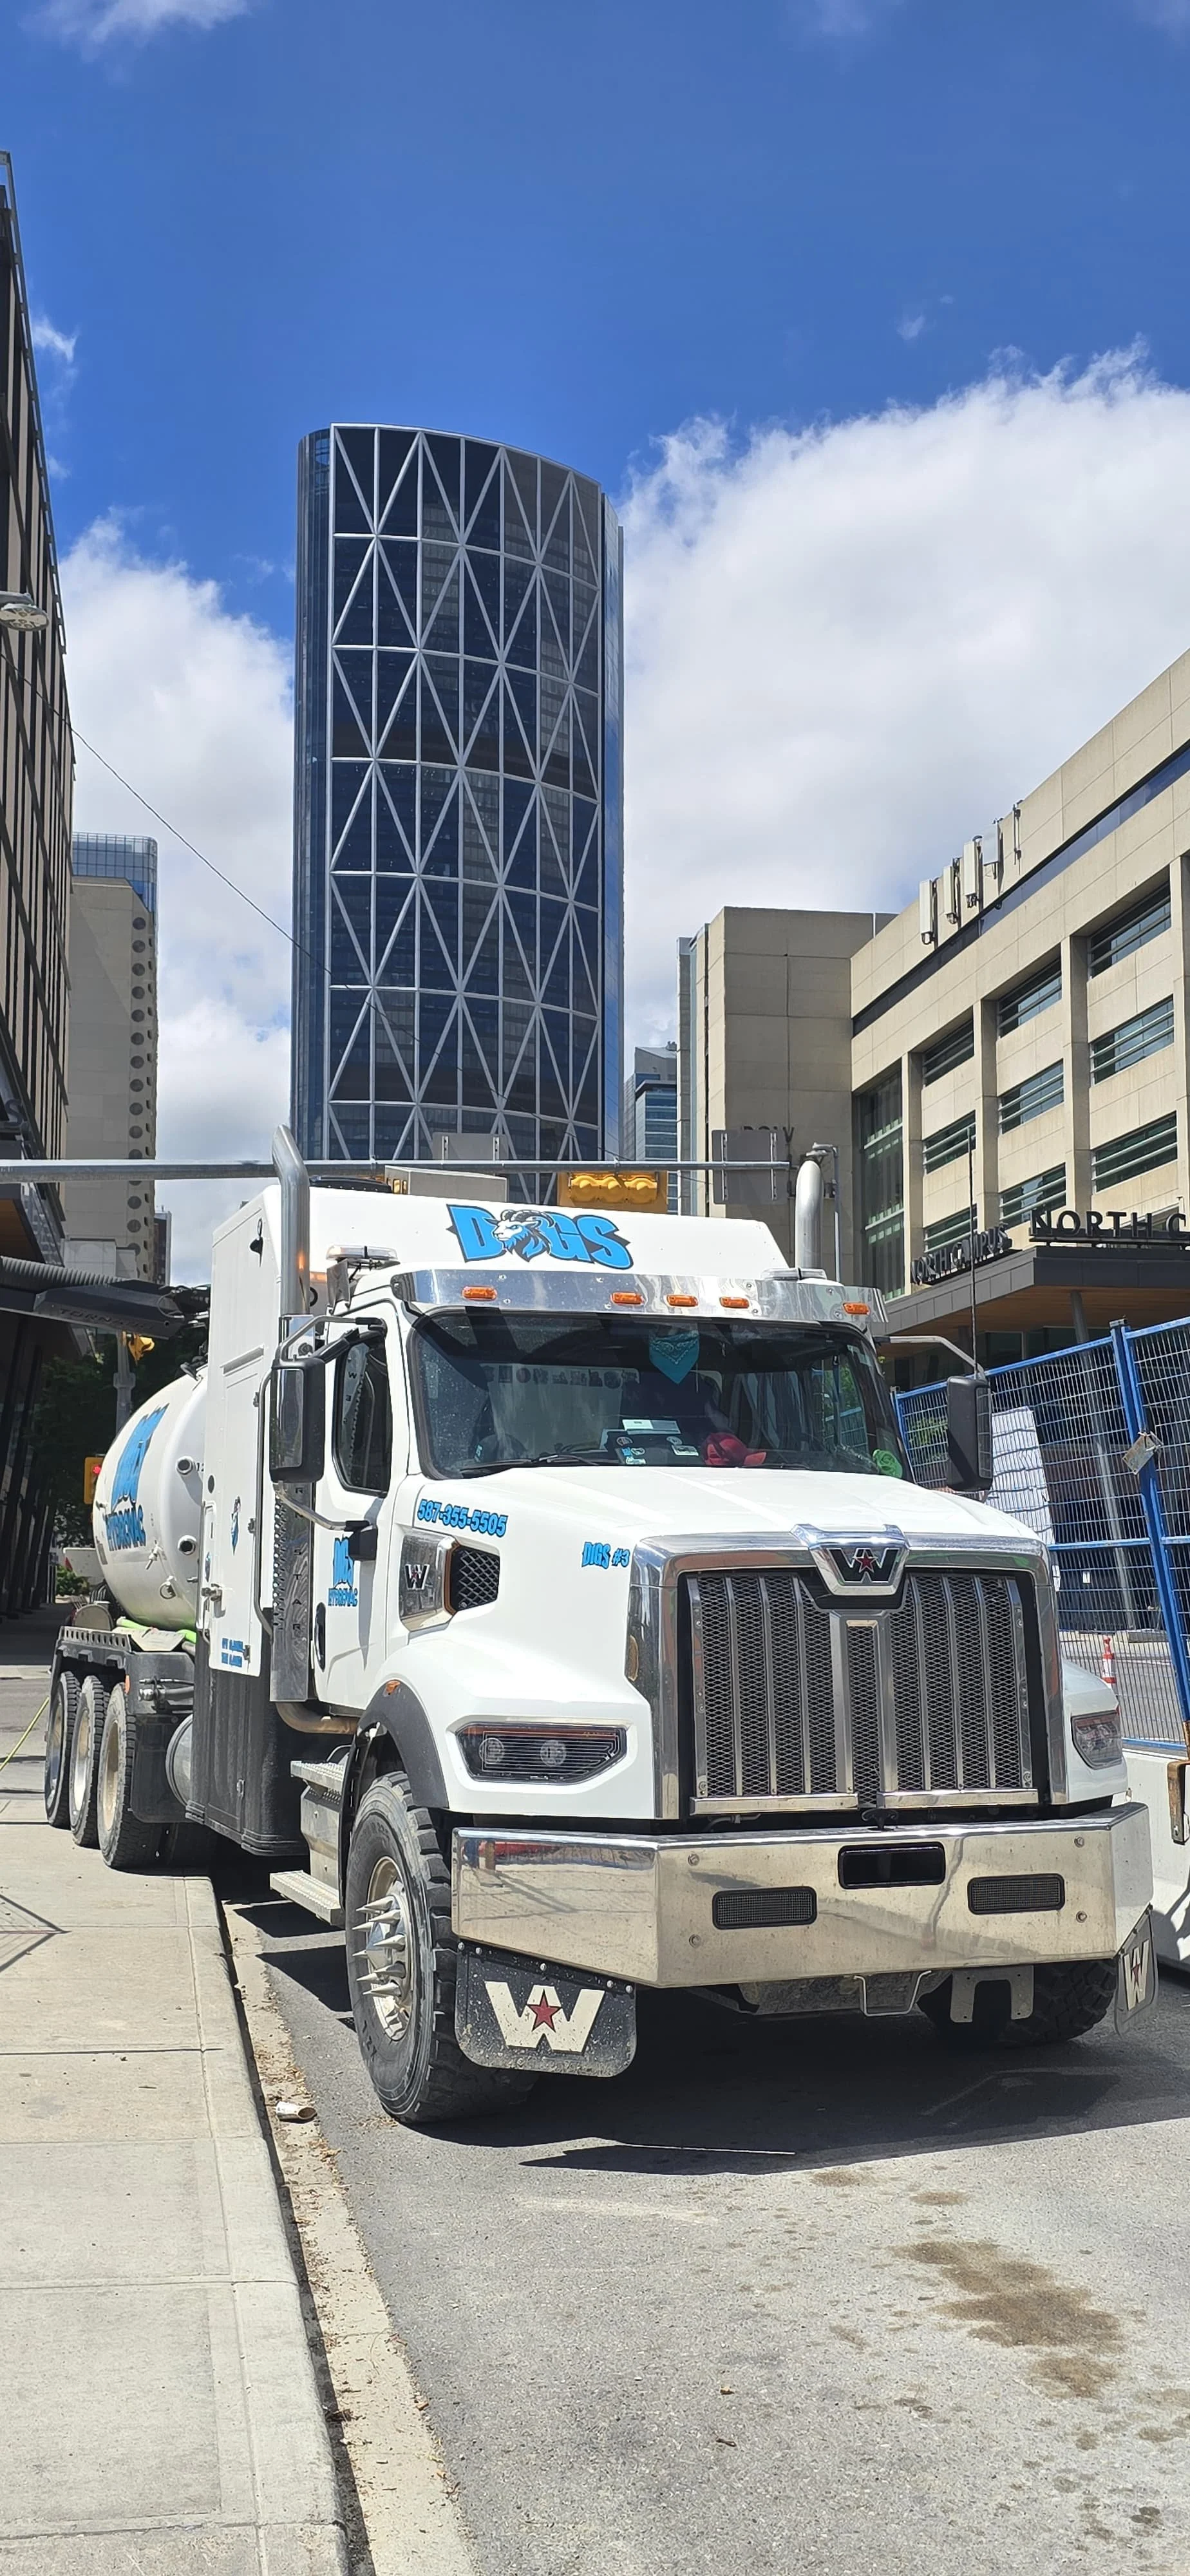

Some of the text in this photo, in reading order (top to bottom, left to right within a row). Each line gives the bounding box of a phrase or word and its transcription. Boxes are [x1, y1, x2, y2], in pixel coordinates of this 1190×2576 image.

[1030, 1209, 1155, 1238] NORTH
[951, 1222, 1011, 1269] CAMPUS
[417, 1499, 508, 1537] 587-355-5505
[581, 1542, 630, 1569] DIGS #3
